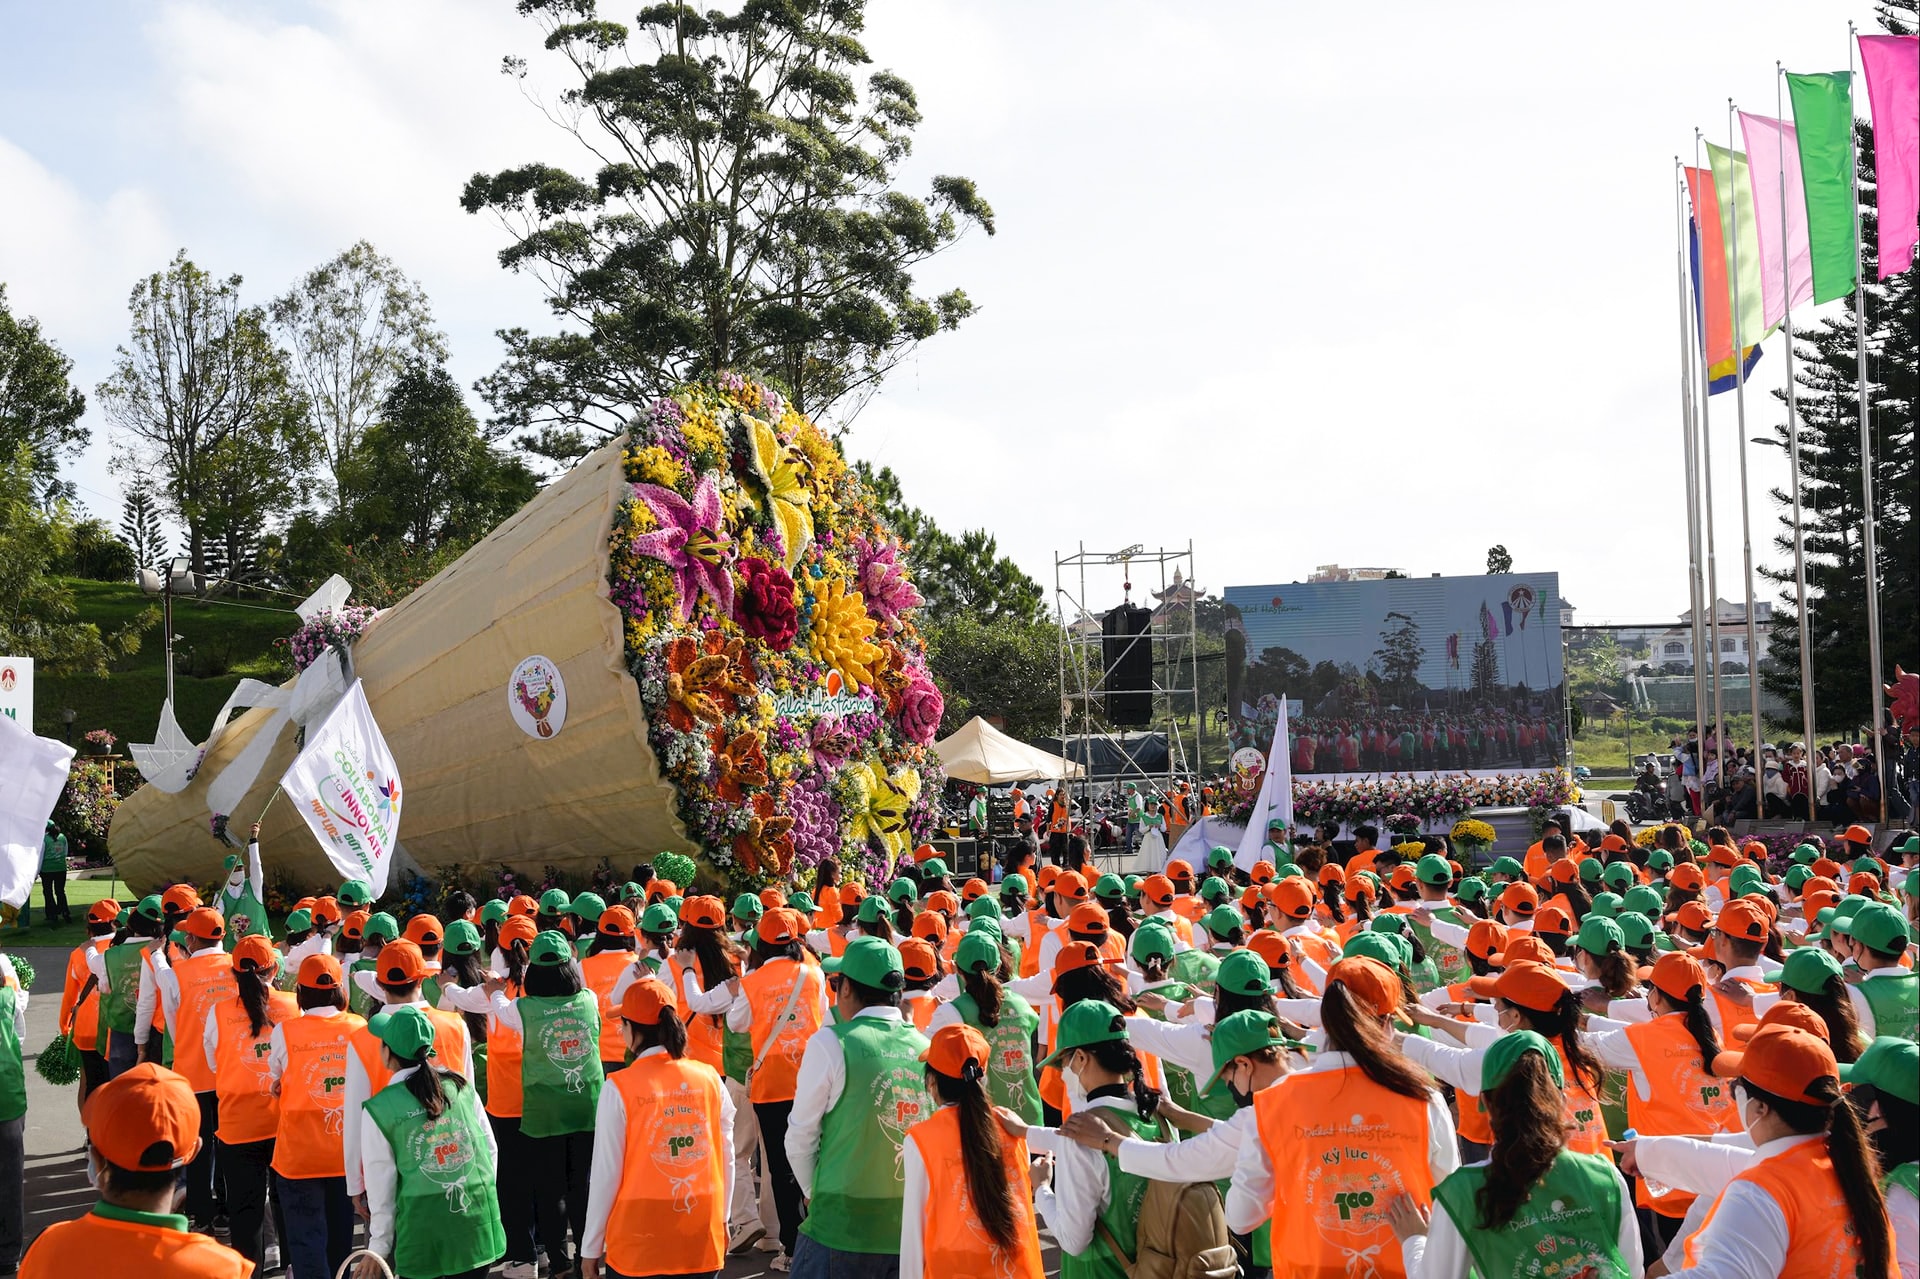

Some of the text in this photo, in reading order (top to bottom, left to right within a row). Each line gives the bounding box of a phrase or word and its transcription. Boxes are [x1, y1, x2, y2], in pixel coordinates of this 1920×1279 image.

[334, 750, 389, 848] COLLABORATE
[333, 779, 383, 859] to INNOVATE
[559, 1038, 579, 1055] 100
[1700, 1086, 1720, 1106] 100
[895, 1100, 920, 1123] 100
[434, 1142, 459, 1165] 100
[668, 1135, 695, 1157] 100
[1344, 1146, 1369, 1161] lục
[1333, 1190, 1375, 1220] 100
